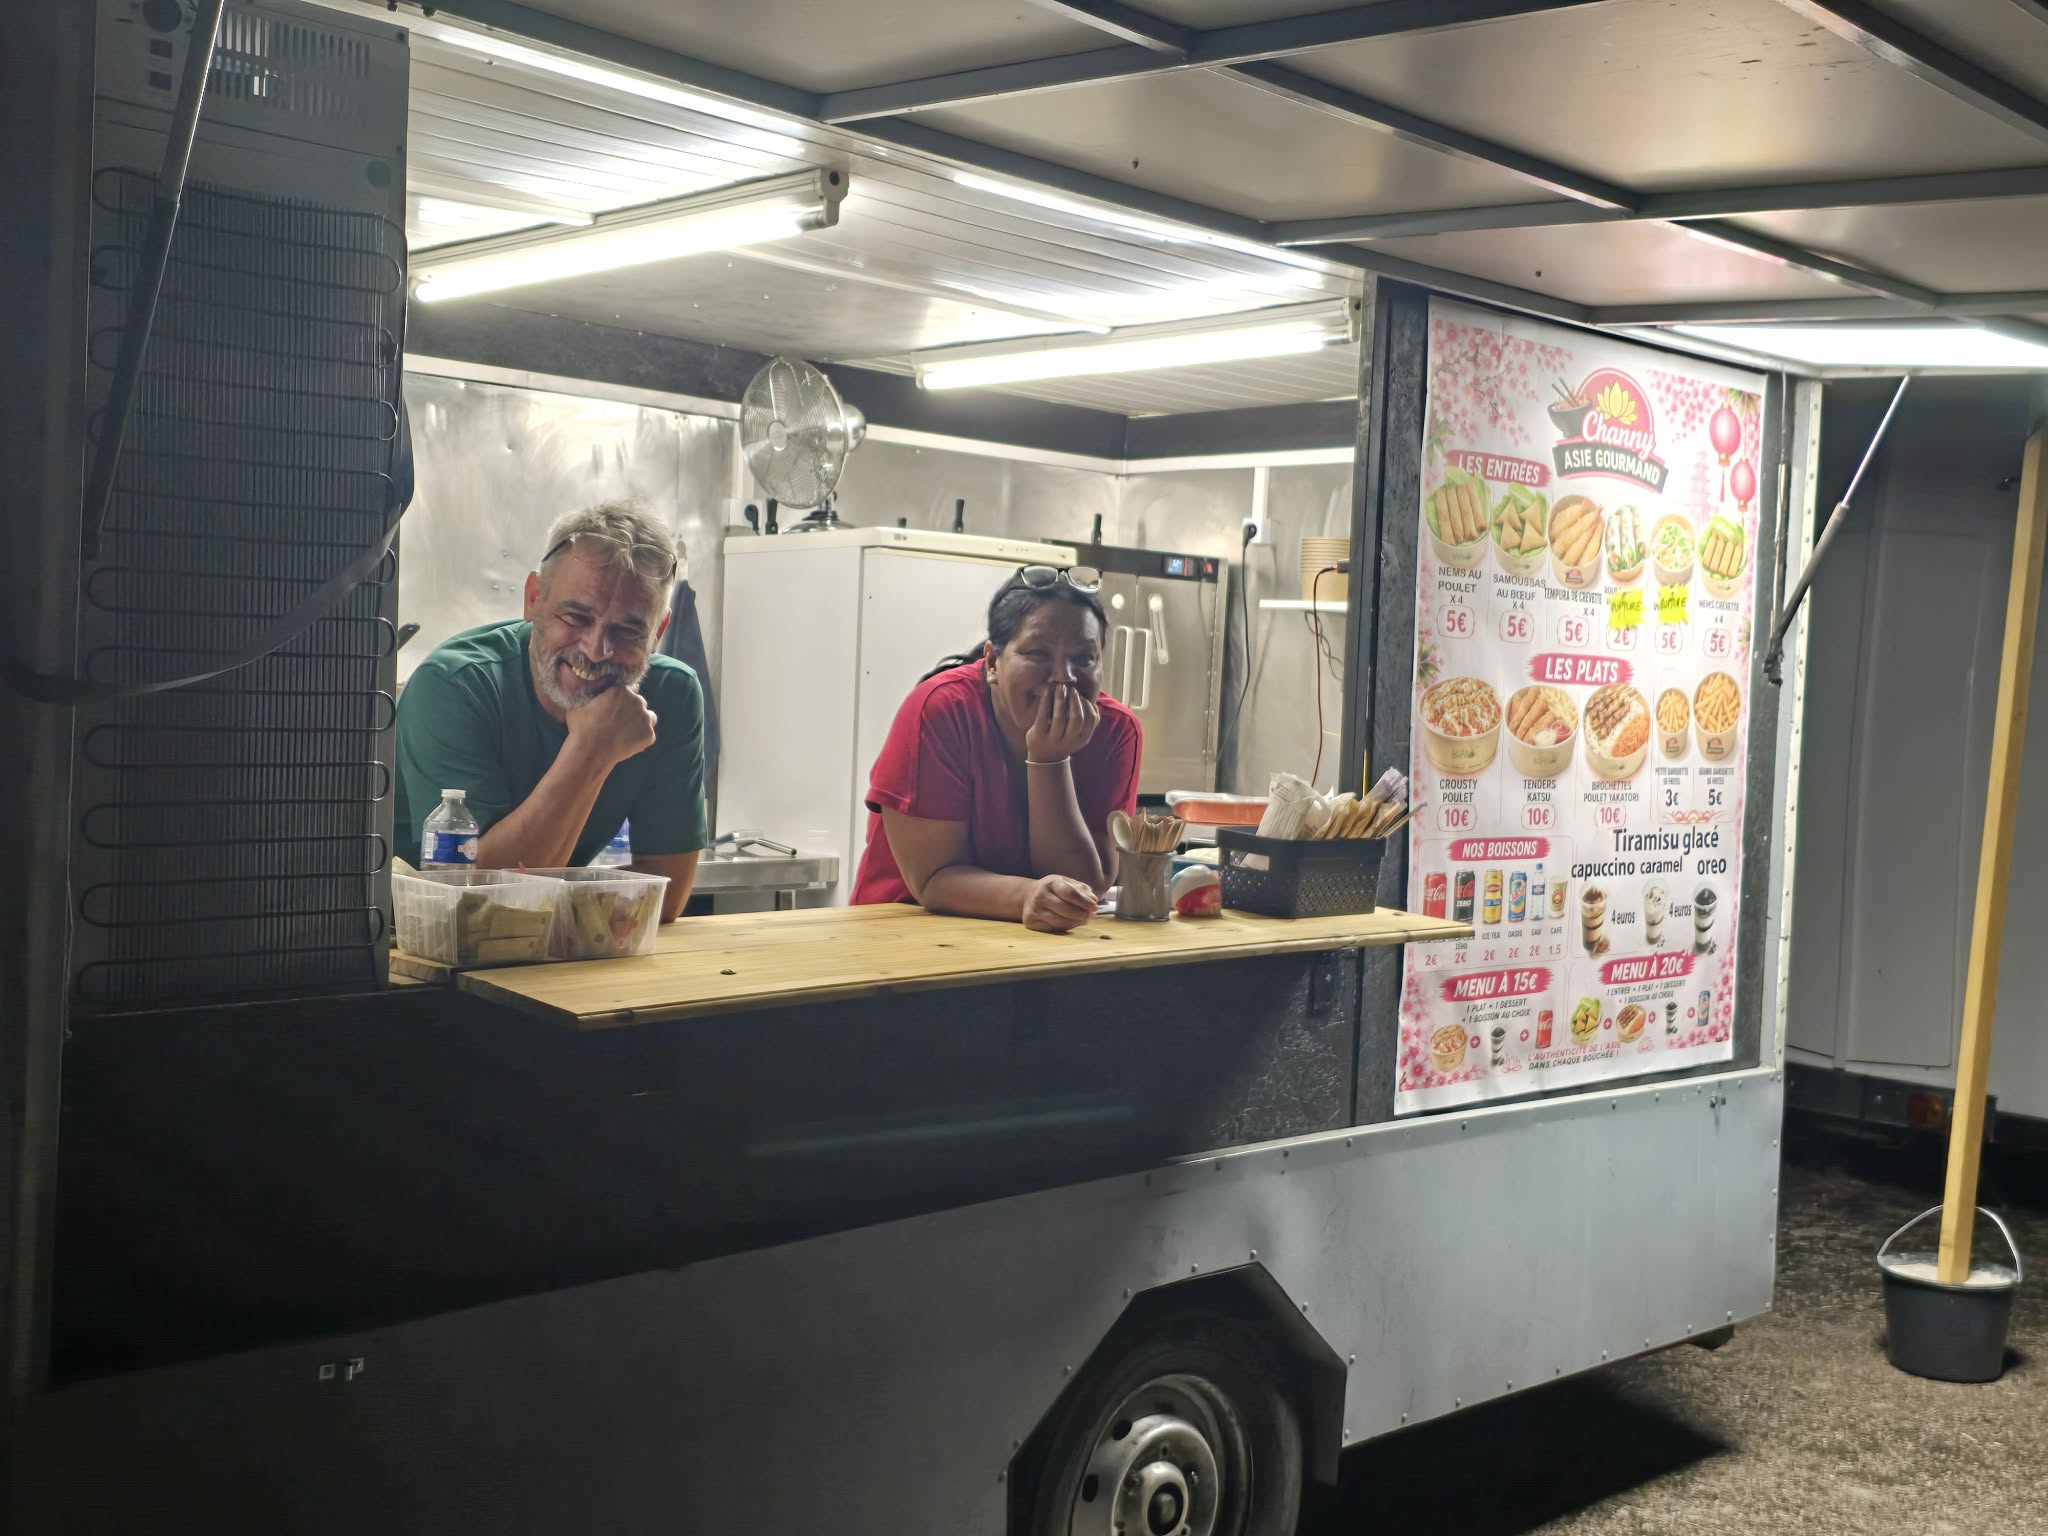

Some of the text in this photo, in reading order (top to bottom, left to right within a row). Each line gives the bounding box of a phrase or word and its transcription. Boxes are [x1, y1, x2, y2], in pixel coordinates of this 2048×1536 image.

[1582, 410, 1654, 460] Channy
[1458, 453, 1541, 485] LES ENTRÉES
[1564, 449, 1661, 485] ASIE GOURMAND
[1438, 567, 1482, 580] NEMS AU
[1492, 573, 1546, 589] SAMOUSSAS
[1438, 581, 1476, 593] POULET
[1496, 588, 1509, 599] AU
[1446, 610, 1467, 633] 5€
[1507, 615, 1527, 637] 5€
[1565, 621, 1583, 643] 5€
[1661, 631, 1677, 649] 5€
[1545, 657, 1619, 683] LES PLATS
[1440, 779, 1478, 790] CROUSTY
[1523, 780, 1556, 790] TENDERS
[1592, 780, 1632, 791] BROCHETTES
[1442, 792, 1474, 803] POULET
[1527, 792, 1551, 802] KATSU
[1583, 792, 1608, 803] POULET
[1665, 788, 1679, 807] 3€
[1708, 788, 1722, 806] 5€
[1444, 808, 1469, 828] 10€
[1527, 808, 1550, 826] 10€
[1600, 806, 1621, 825] 10€
[1613, 825, 1719, 856] Tiramisu glacé
[1462, 841, 1538, 859] NOS BOISSONS
[1571, 856, 1727, 882] capuccino caramel oreo
[1611, 909, 1636, 925] 4 euros
[1669, 903, 1692, 918] 4 euros
[1455, 951, 1467, 963] 2€
[1484, 949, 1495, 961] 2€
[1508, 947, 1519, 959] 2€
[1529, 945, 1541, 957] 2€
[1425, 954, 1437, 966] 2€
[1610, 956, 1684, 983] MENU À 20€
[1453, 971, 1538, 999] MENU À 15€
[1471, 1003, 1487, 1012] PLAT
[1500, 998, 1528, 1008] DESSERT
[1473, 1012, 1500, 1023] BOISSON
[1501, 1010, 1511, 1019] AU
[1588, 1043, 1598, 1053] DE
[1529, 1060, 1550, 1071] DANS
[1552, 1055, 1581, 1068] CHAQUE
[1582, 1050, 1614, 1063] BOUCHÉE
